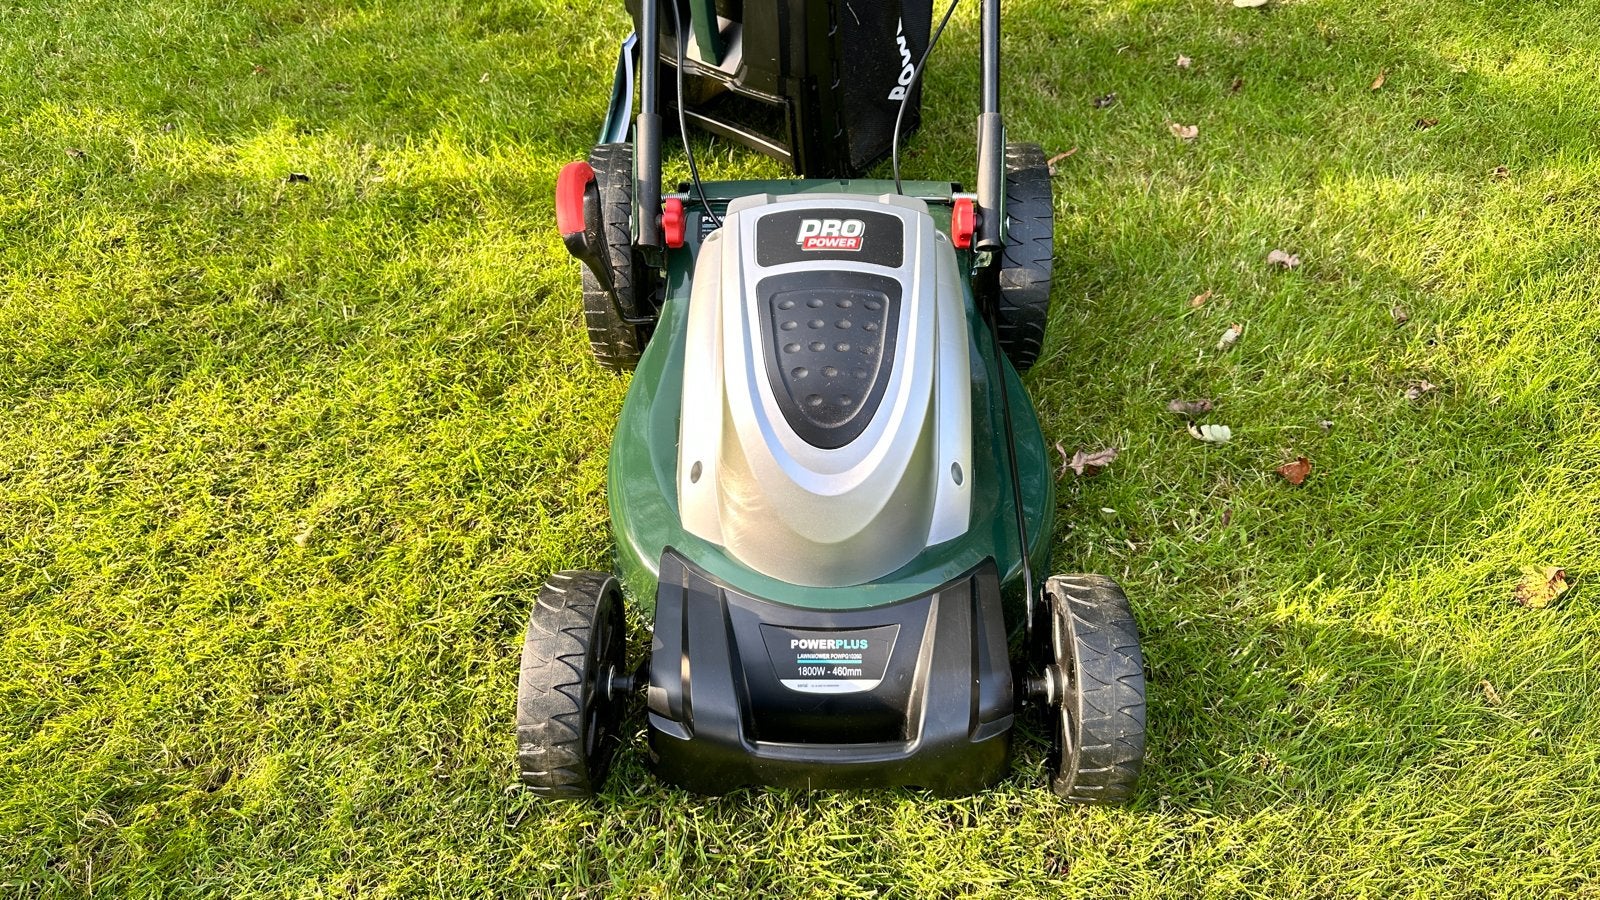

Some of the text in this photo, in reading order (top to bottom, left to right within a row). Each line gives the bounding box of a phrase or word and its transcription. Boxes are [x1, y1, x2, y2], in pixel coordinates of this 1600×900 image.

[797, 219, 865, 244] PRO
[807, 238, 857, 248] POWER
[790, 639, 868, 649] POWERPLUS
[797, 666, 825, 676] 1800W
[832, 666, 862, 676] 460mm
